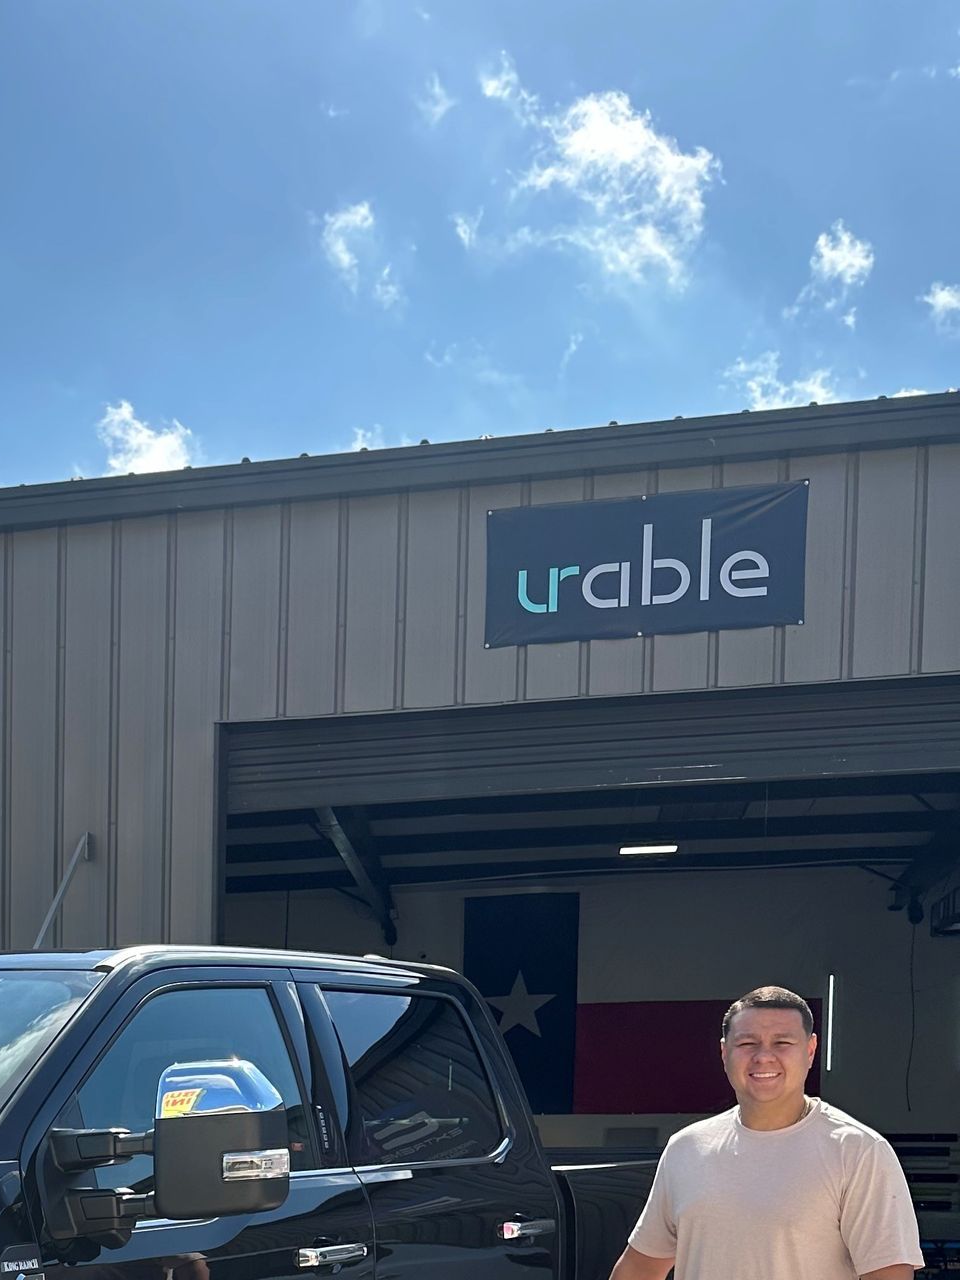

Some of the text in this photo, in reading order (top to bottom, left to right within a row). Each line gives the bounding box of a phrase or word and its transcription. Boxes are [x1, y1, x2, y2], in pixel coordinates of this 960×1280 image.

[517, 518, 770, 614] urable
[2, 1258, 39, 1272] KING RANCH
